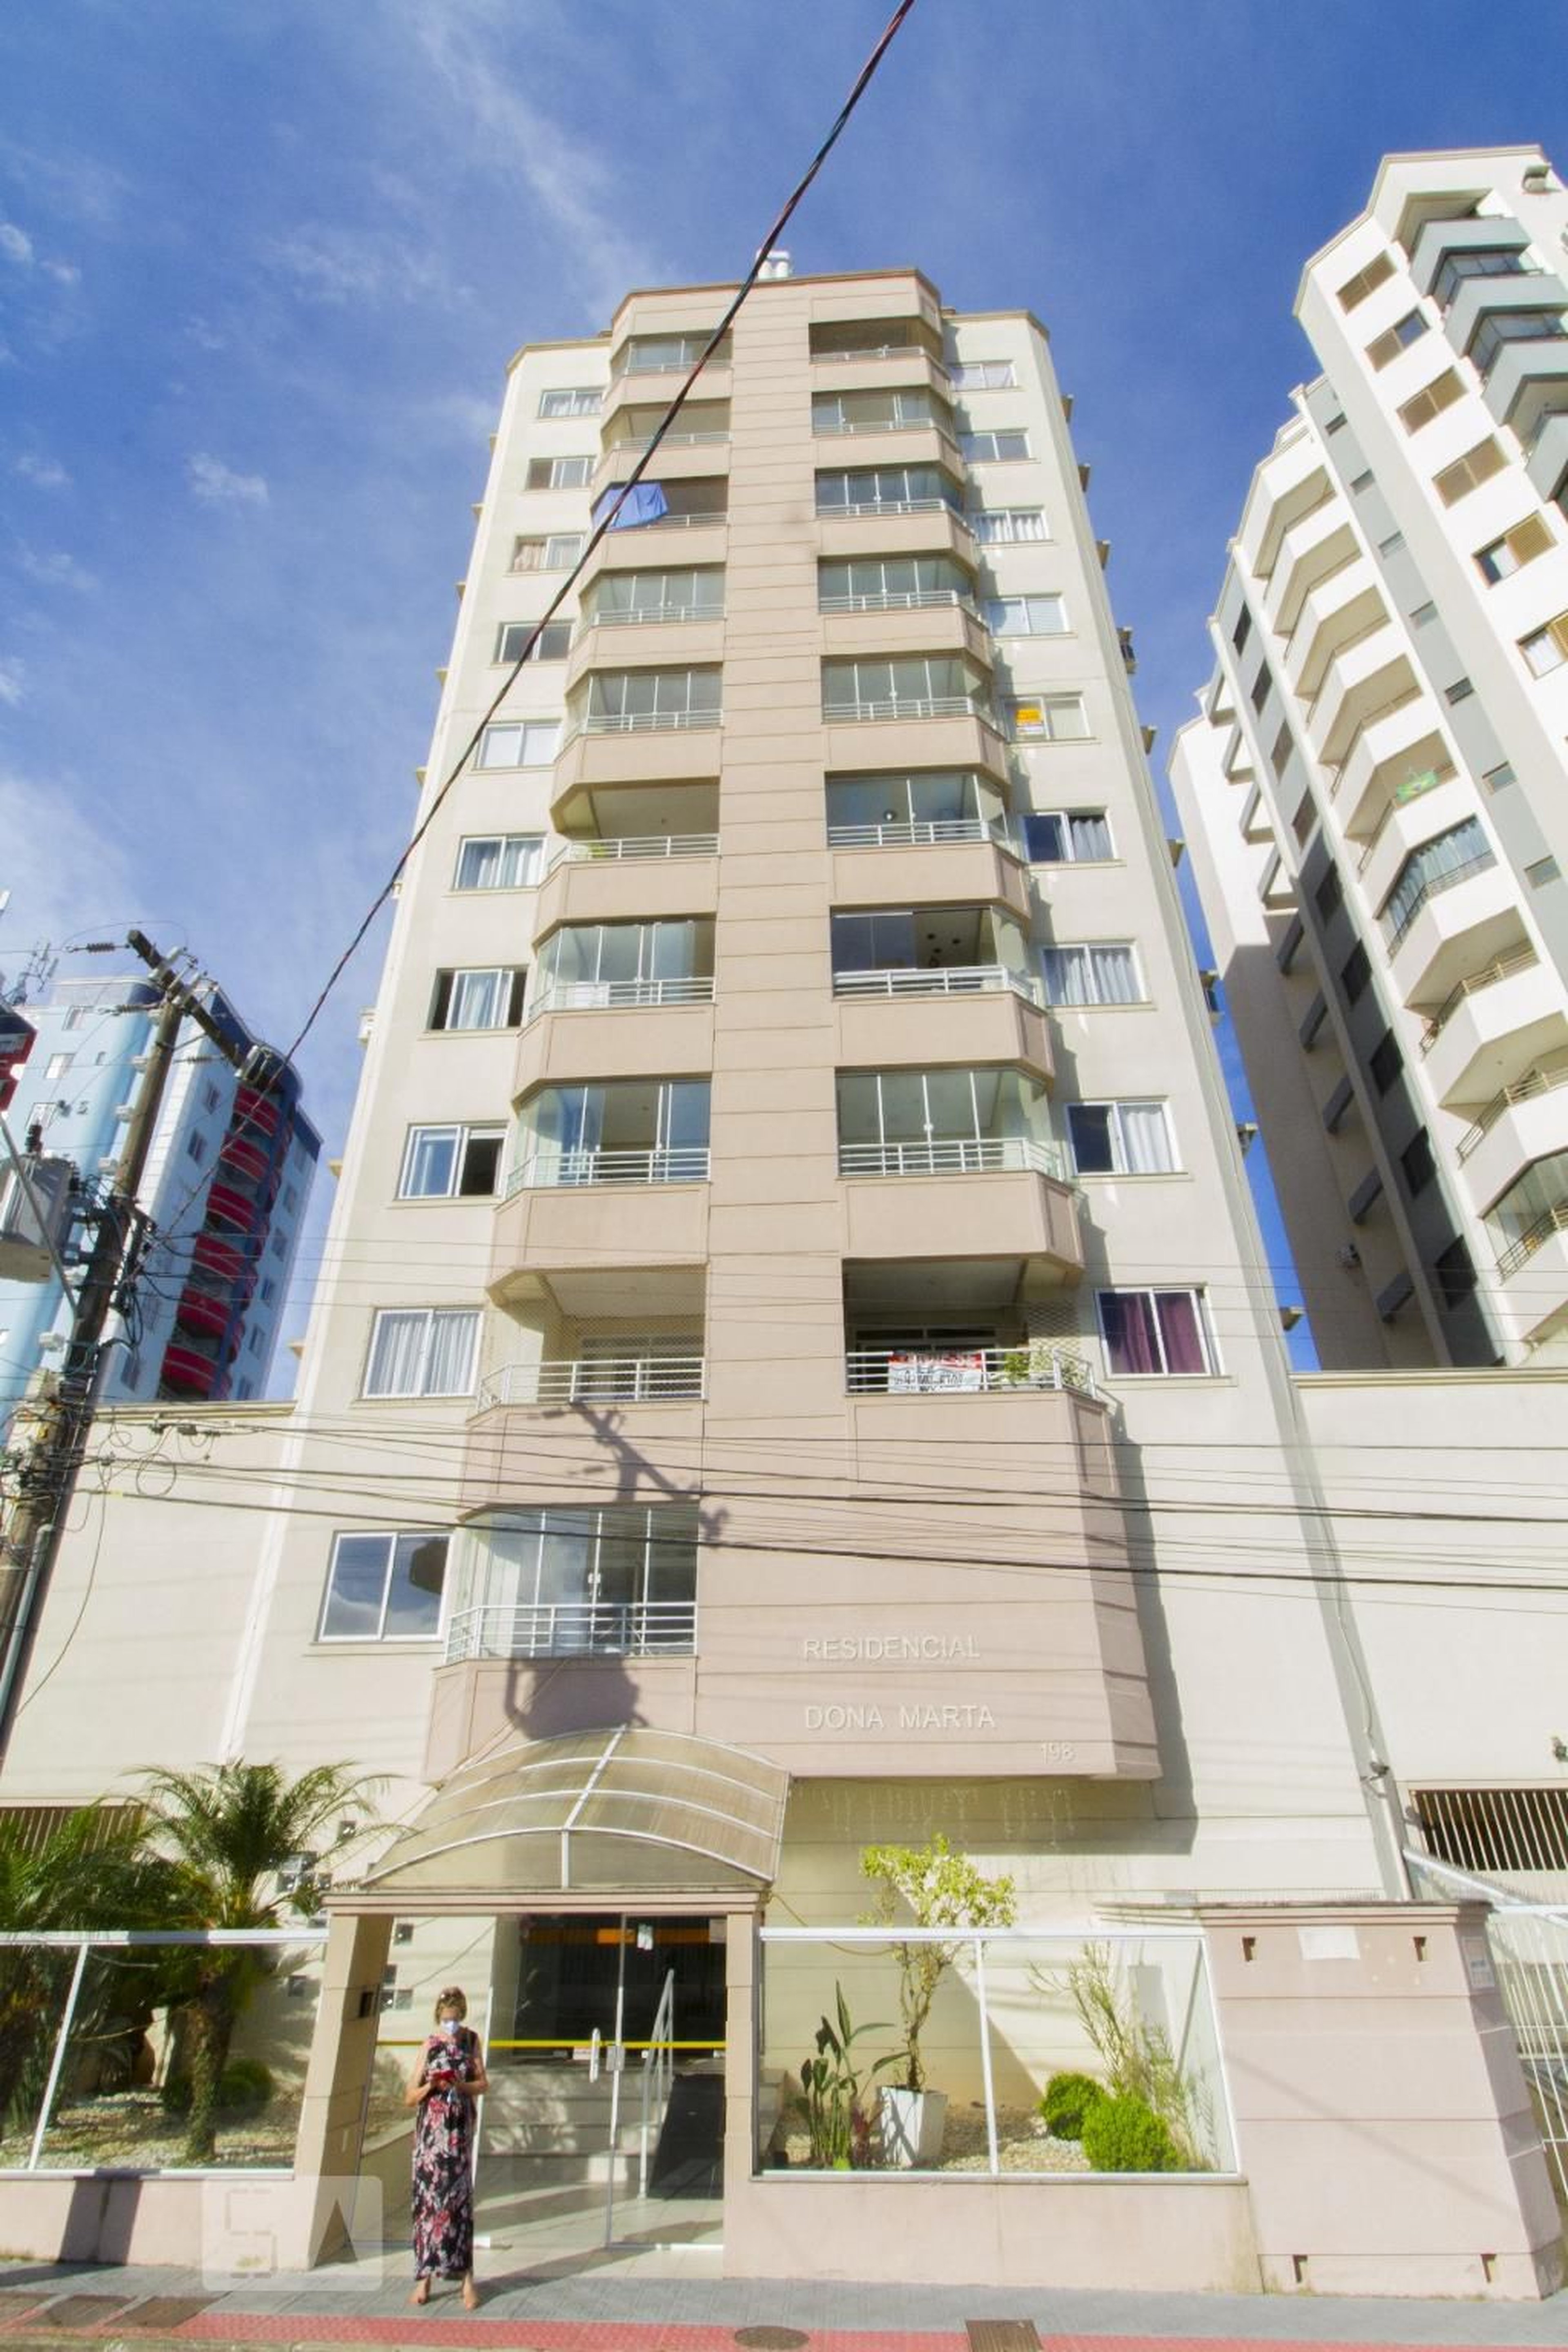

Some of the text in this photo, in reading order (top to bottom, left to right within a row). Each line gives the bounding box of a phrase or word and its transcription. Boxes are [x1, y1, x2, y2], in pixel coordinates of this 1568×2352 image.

[804, 1635, 981, 1661] RESIDENCIAL
[806, 1704, 996, 1730] DONA MARTA
